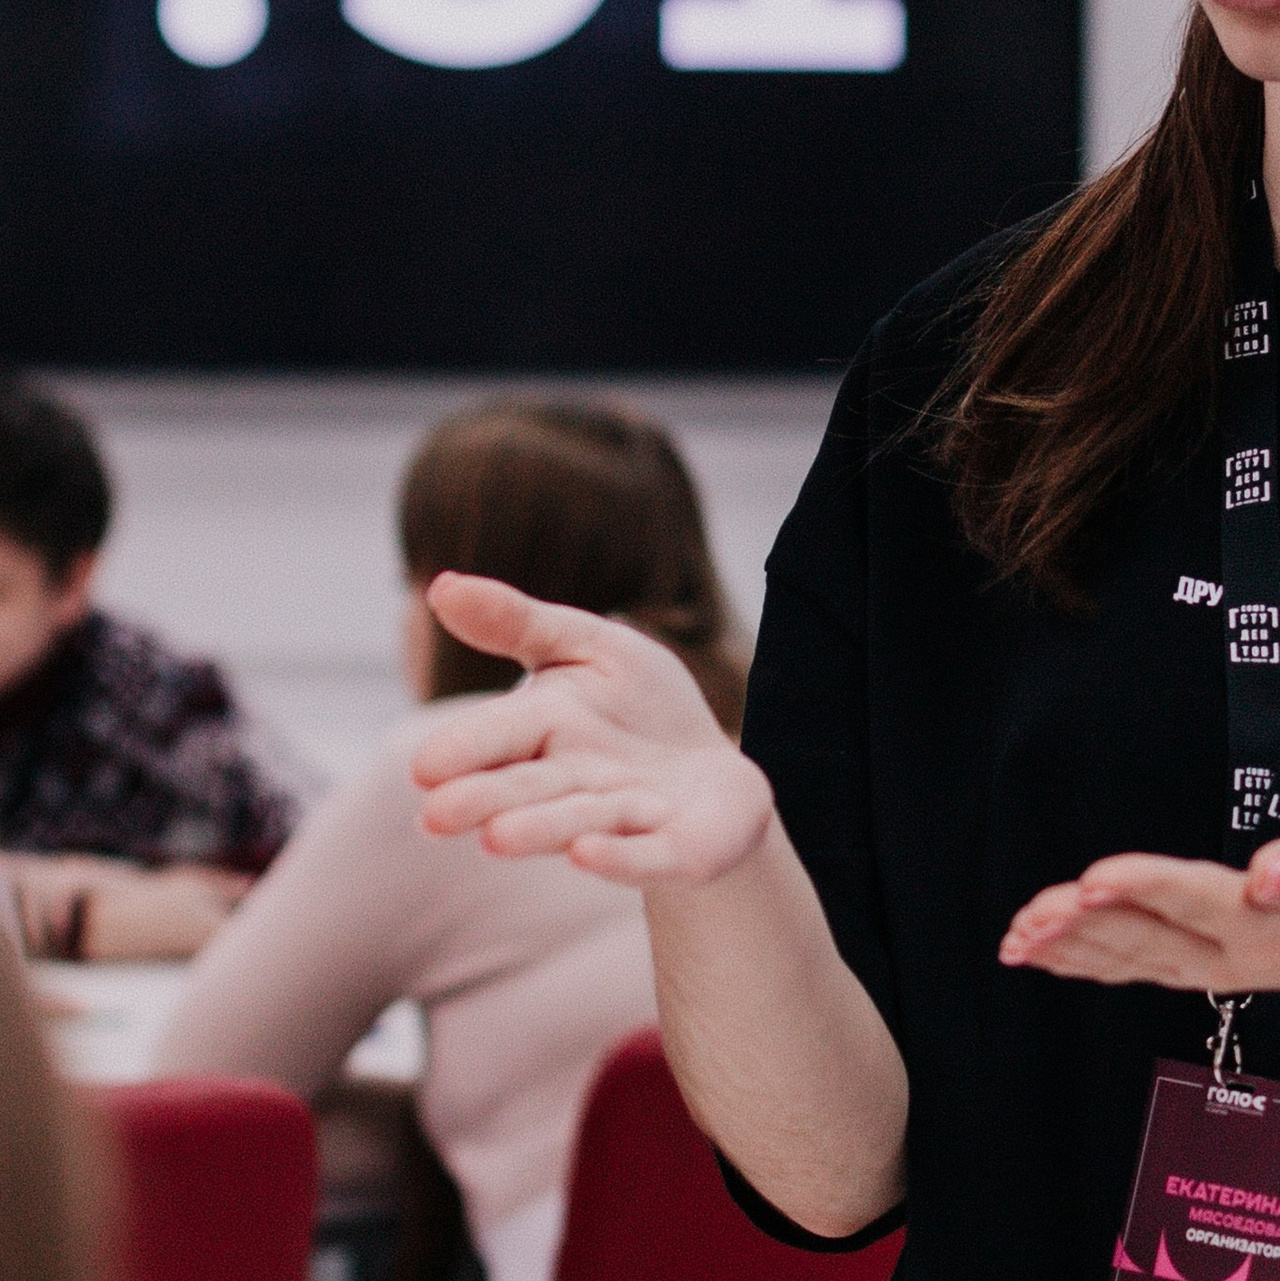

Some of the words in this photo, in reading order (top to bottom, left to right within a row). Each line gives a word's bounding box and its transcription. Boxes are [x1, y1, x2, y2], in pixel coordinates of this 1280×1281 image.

[1173, 575, 1223, 607] ДРУ
[1243, 793, 1261, 807] ДЕ
[1244, 811, 1260, 825] ТО
[1207, 1086, 1267, 1112] ГОЛОС
